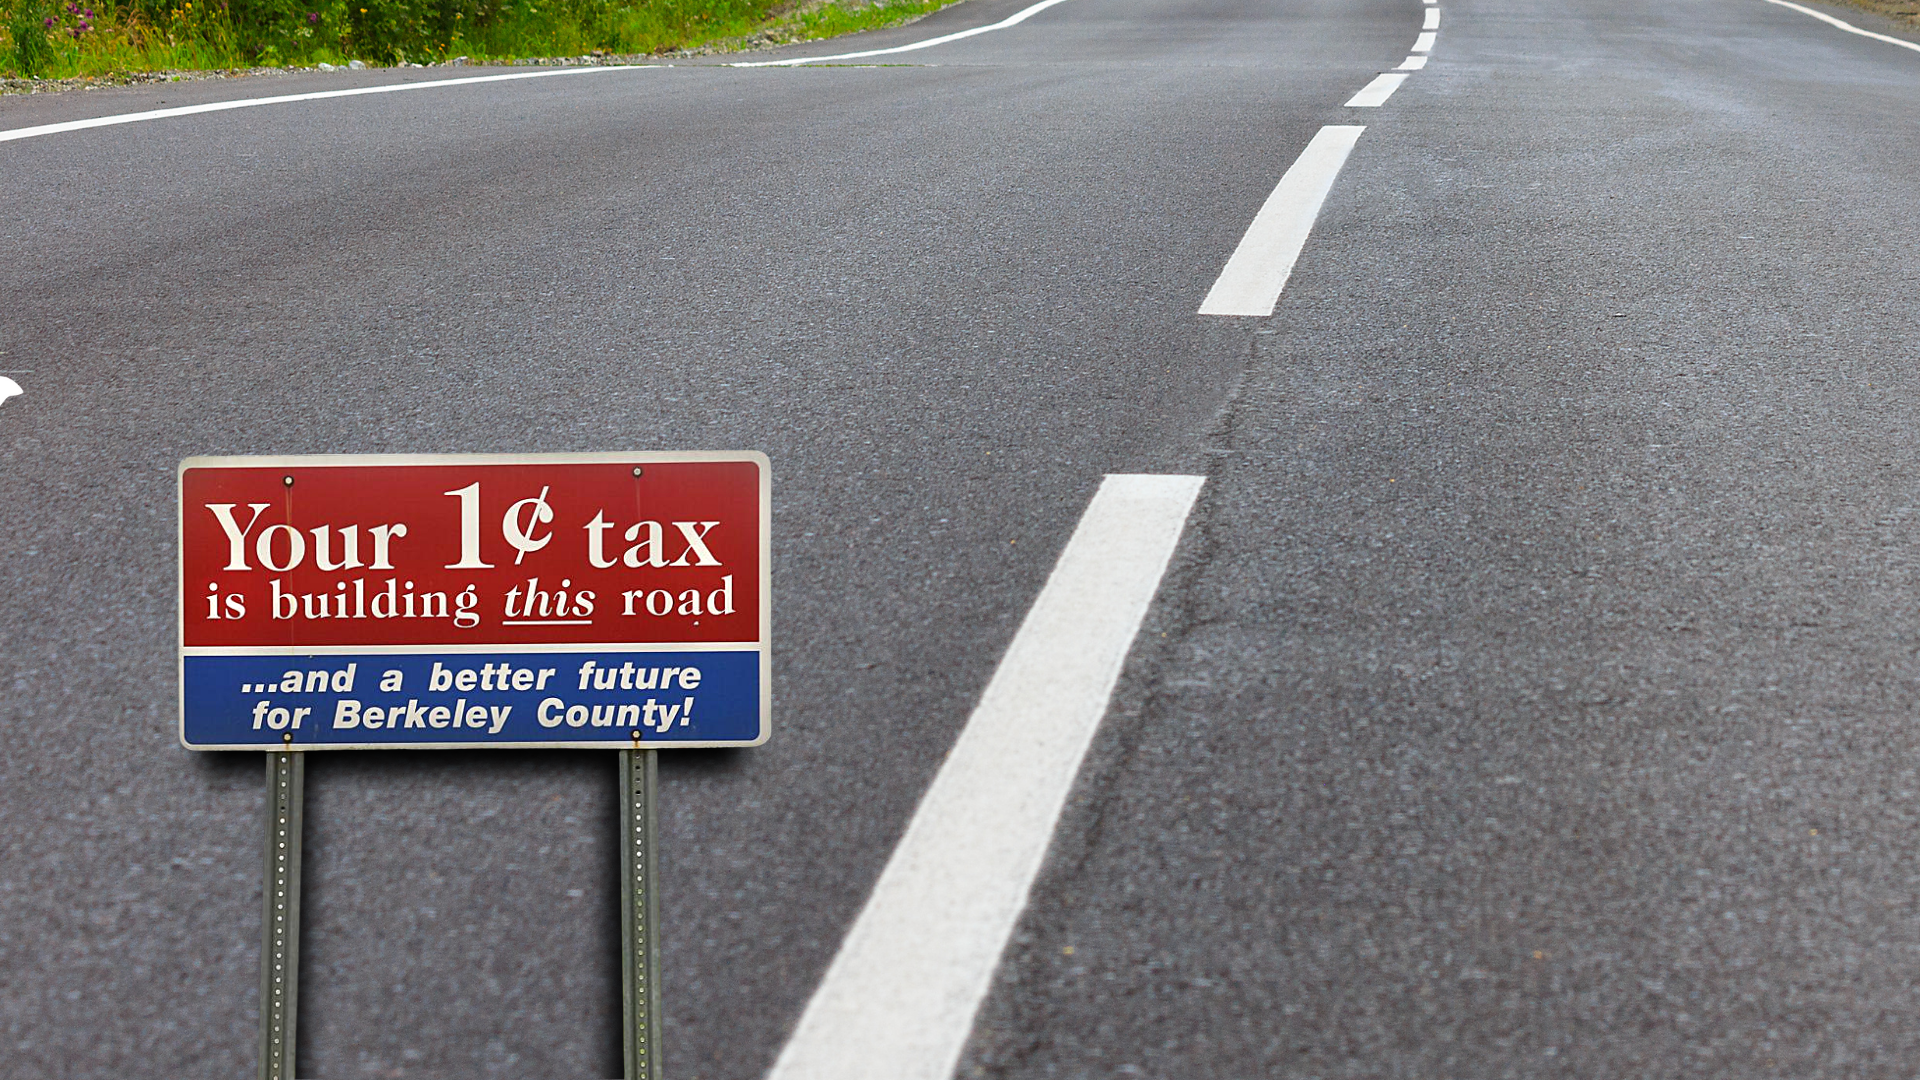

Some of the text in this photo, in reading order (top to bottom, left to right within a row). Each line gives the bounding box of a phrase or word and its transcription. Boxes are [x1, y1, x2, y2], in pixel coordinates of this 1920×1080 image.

[205, 481, 723, 572] Your 1¢ tax
[206, 574, 736, 629] is building this road
[241, 660, 702, 694] ...and a better future
[251, 696, 695, 734] for Berkeley County!
